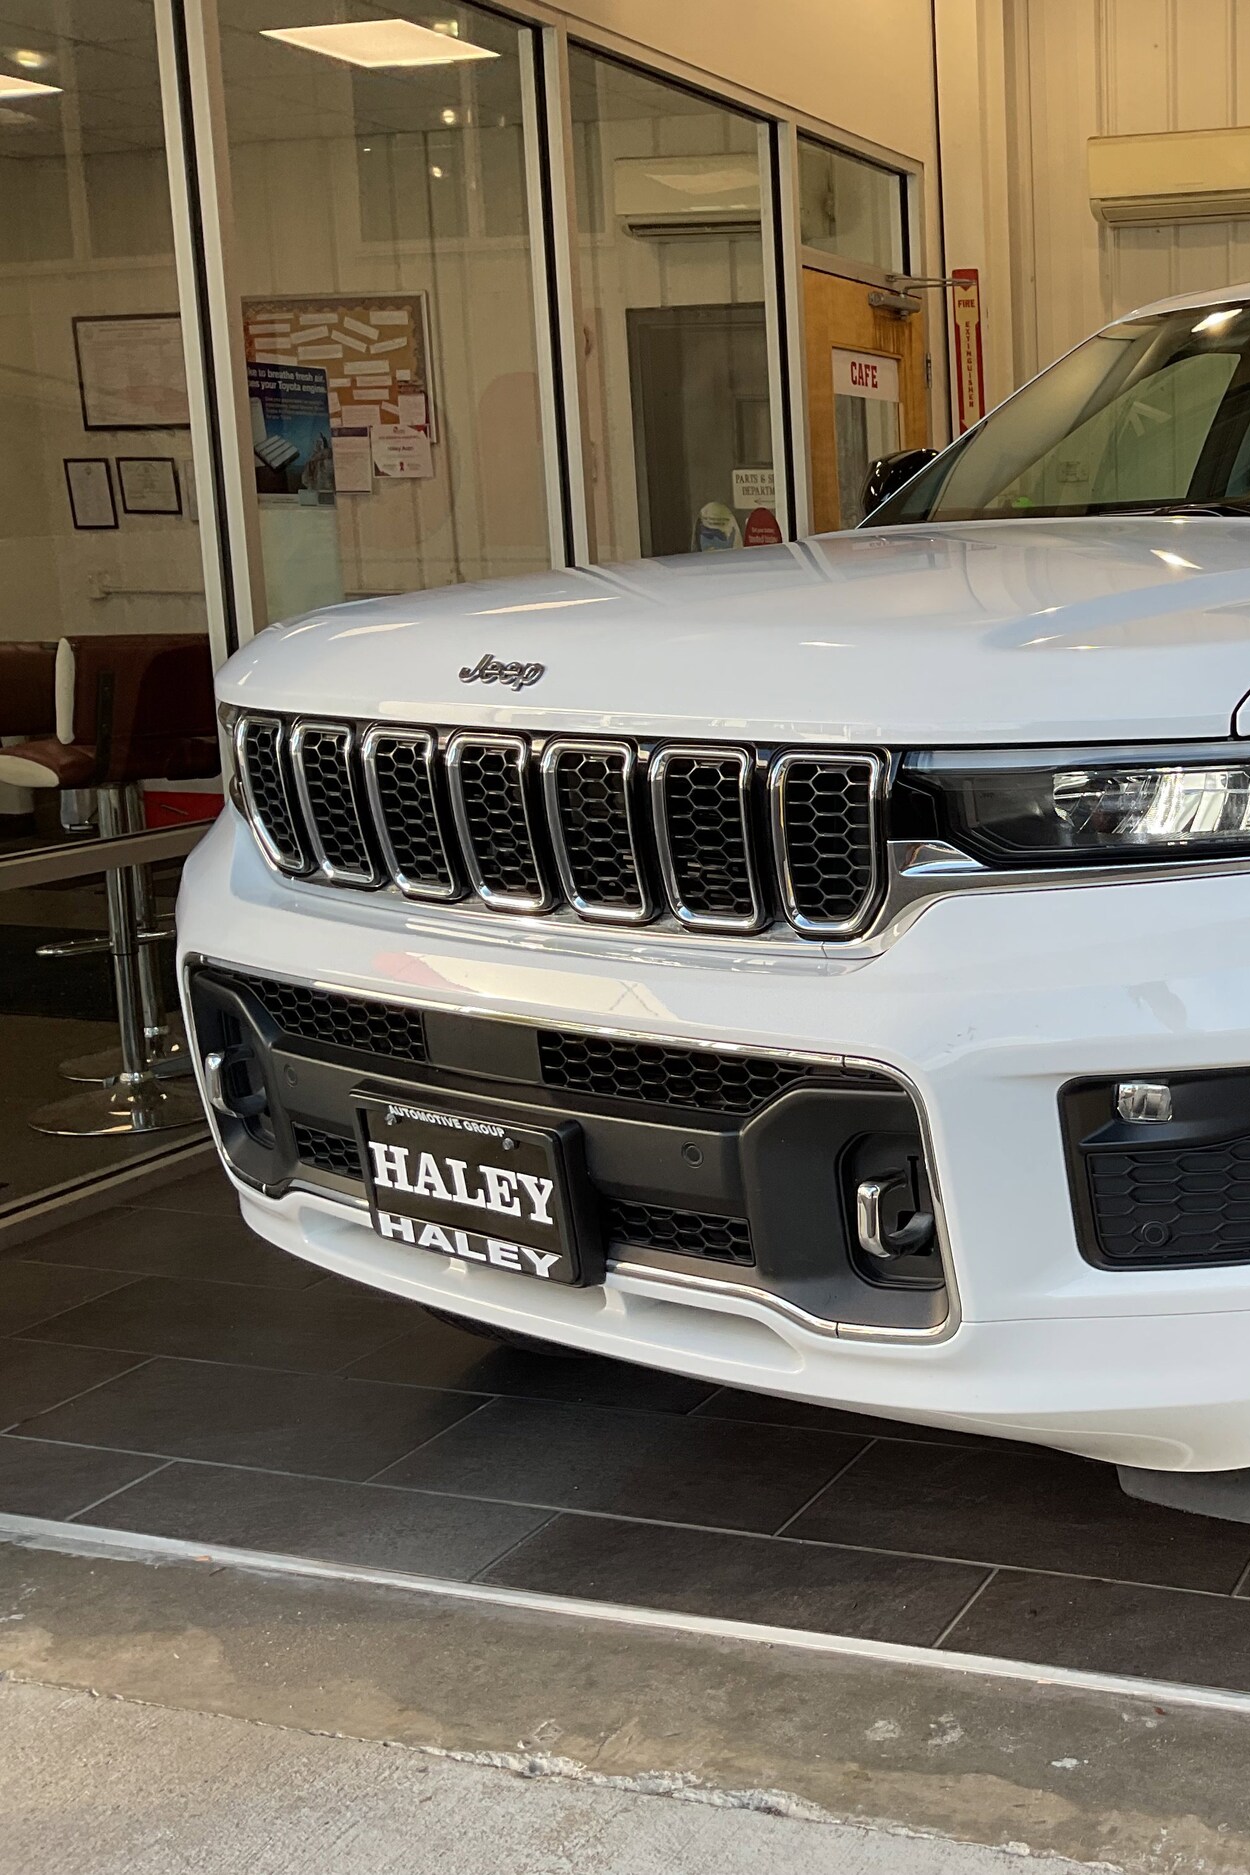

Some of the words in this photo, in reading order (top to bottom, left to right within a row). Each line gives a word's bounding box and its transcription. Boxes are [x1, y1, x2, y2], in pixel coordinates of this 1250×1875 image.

[958, 299, 975, 308] FIRE
[267, 369, 294, 380] breathe
[851, 361, 878, 389] CAFE
[965, 321, 974, 408] EXTINGUISHER
[278, 381, 301, 392] Toyota
[735, 473, 758, 484] PARTS
[760, 474, 766, 483] &
[459, 653, 545, 692] Jeep
[388, 1104, 463, 1130] AUTOMOTIVE
[463, 1121, 505, 1138] GROUP
[368, 1140, 554, 1225] HALEY
[378, 1212, 563, 1278] HALEY
